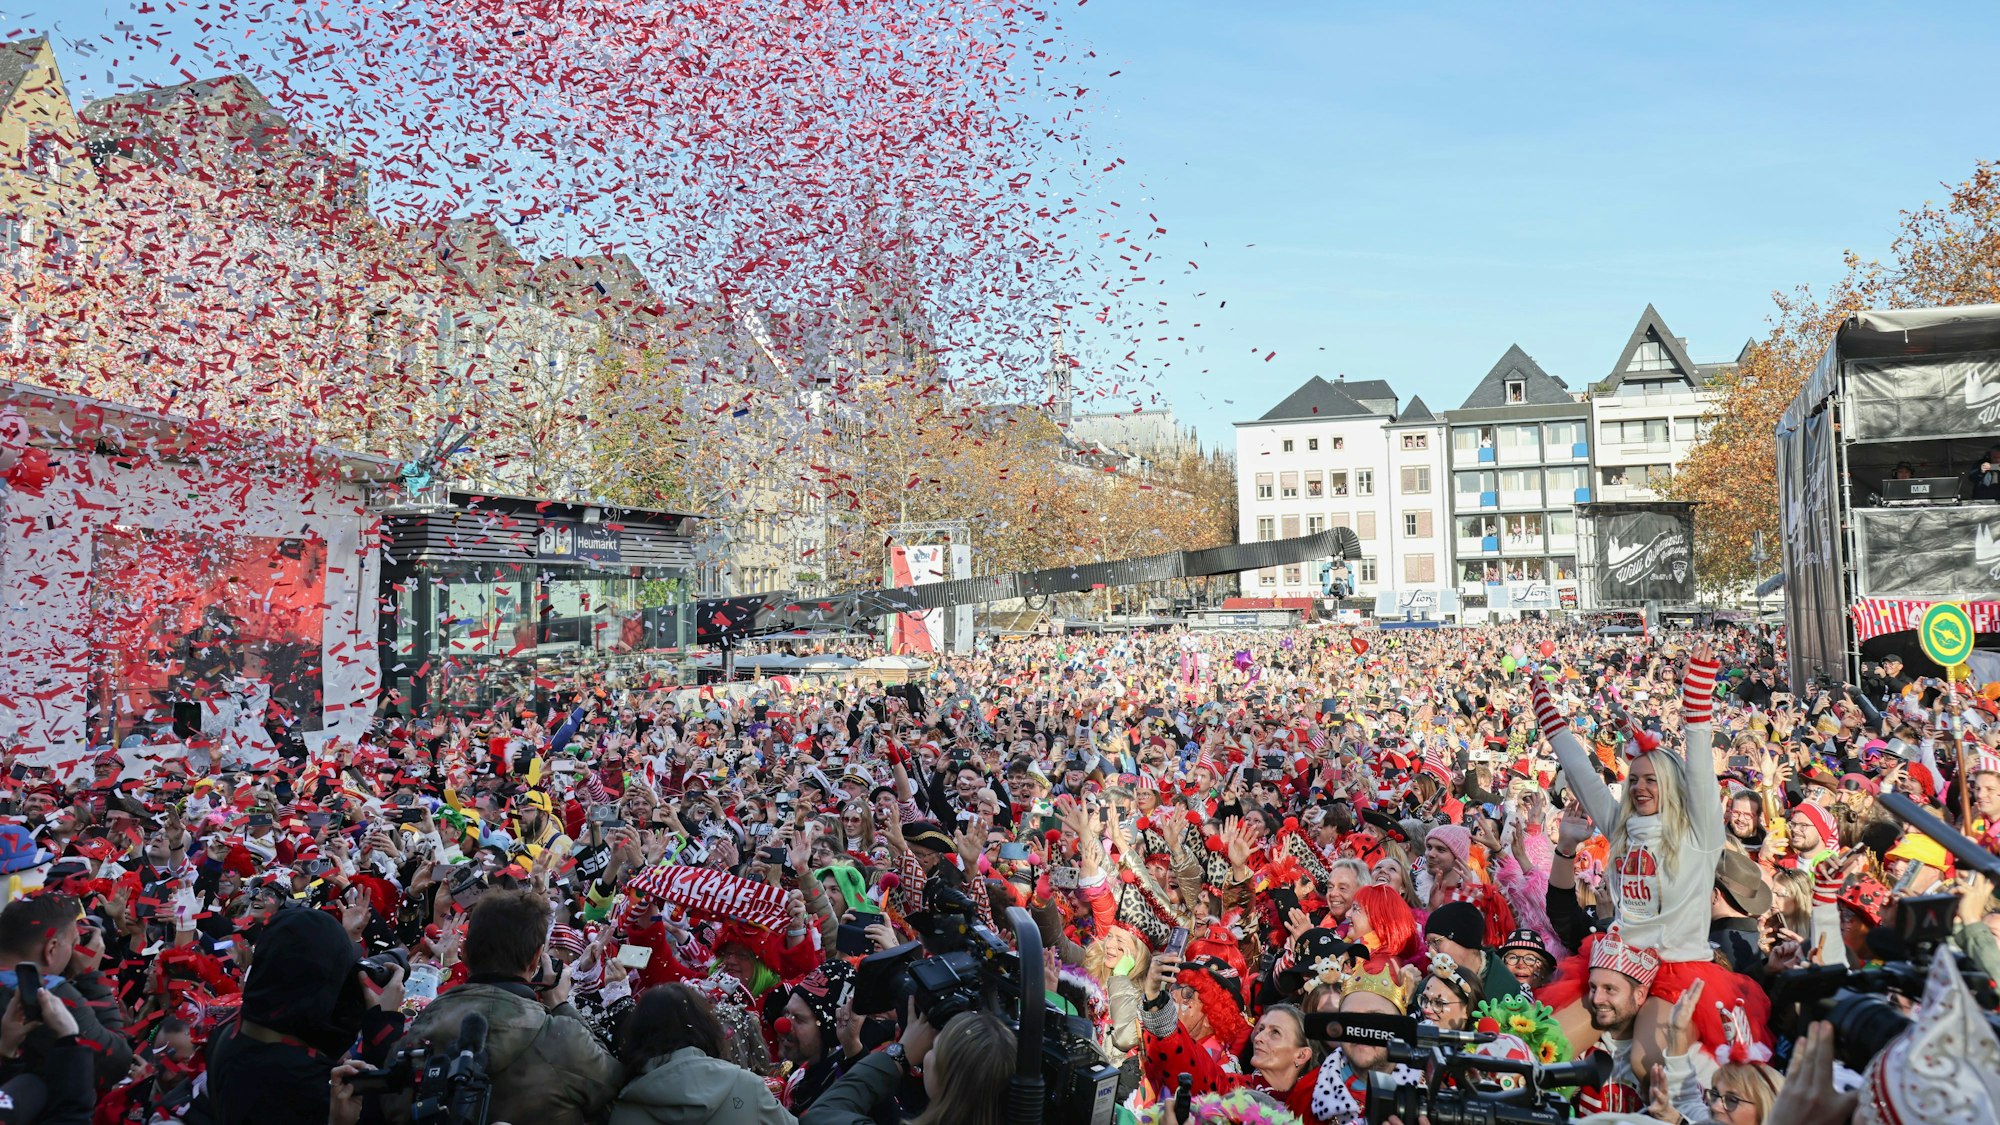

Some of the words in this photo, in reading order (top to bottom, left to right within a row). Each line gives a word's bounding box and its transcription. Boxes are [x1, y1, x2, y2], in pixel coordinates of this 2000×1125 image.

[577, 536, 617, 550] Heumarkt
[1346, 1025, 1395, 1041] REUTERS
[1531, 1112, 1554, 1120] SONY
